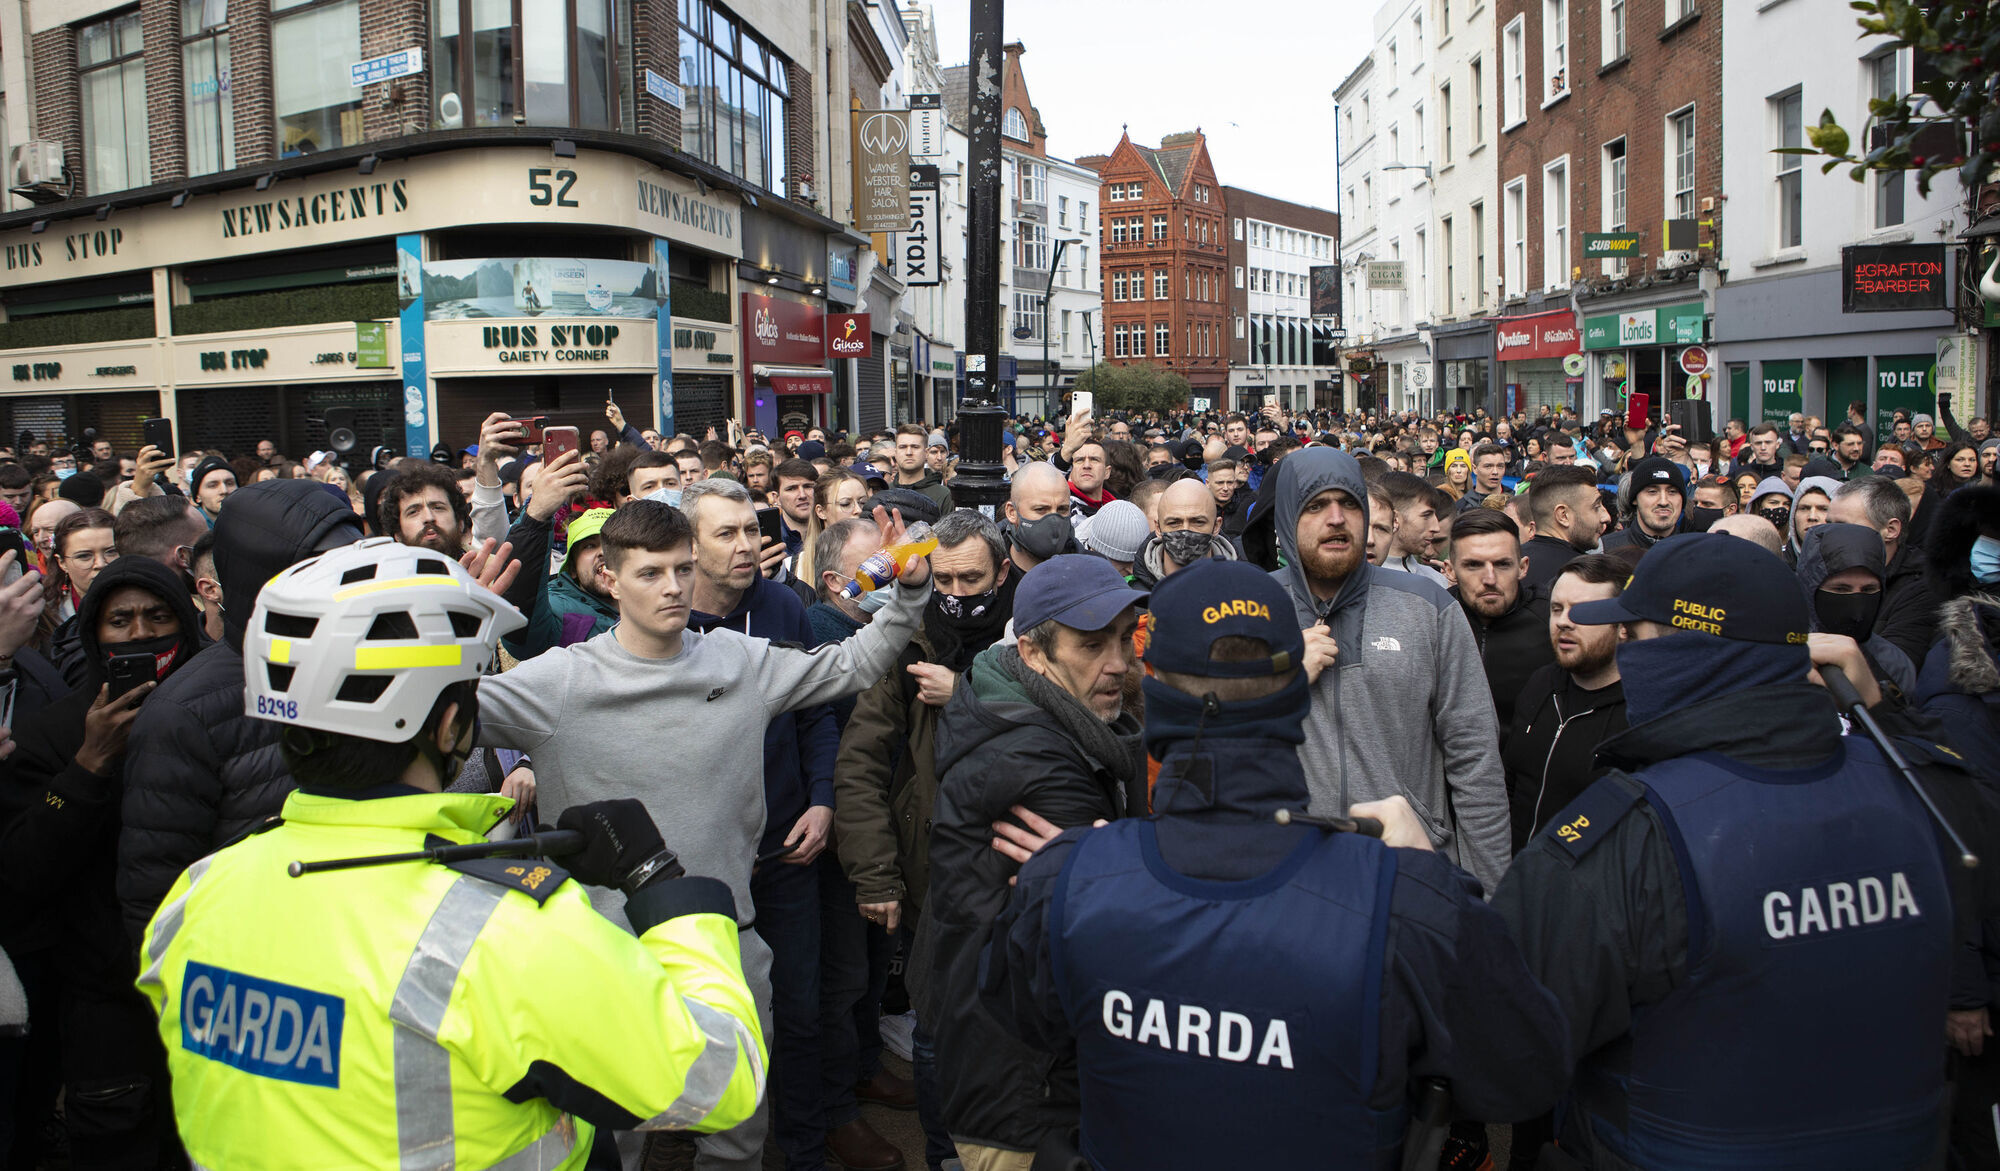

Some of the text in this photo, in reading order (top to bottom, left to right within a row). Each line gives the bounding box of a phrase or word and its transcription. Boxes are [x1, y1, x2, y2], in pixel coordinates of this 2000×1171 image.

[922, 111, 930, 154] FUJIFILM
[868, 163, 898, 174] WAYNE
[528, 168, 579, 208] 52
[864, 175, 907, 188] WEBSTER
[874, 187, 897, 198] HAIR
[222, 179, 409, 239] NEWSAGENTS
[637, 179, 733, 240] NEWSAGENTS
[871, 198, 899, 208] SALON
[907, 195, 931, 277] instax
[1588, 239, 1635, 251] SUBWAY
[6, 228, 124, 271] BUS STOP
[554, 271, 585, 279] UNSEEN
[1371, 271, 1402, 279] CIGAR
[1865, 262, 1942, 277] GRAFTON
[1864, 279, 1931, 293] BARBER
[755, 309, 778, 340] Gino's
[1623, 321, 1652, 341] Londis
[483, 324, 620, 349] BUS STOP
[832, 337, 864, 352] Gino's
[1504, 331, 1531, 347] vodafone
[231, 348, 269, 369] STOP
[499, 349, 609, 363] GAIETY CORNER
[33, 362, 62, 381] STOP
[1413, 366, 1427, 385] 3
[1880, 371, 1924, 388] TO LET
[1937, 366, 1956, 377] MHR
[1764, 379, 1796, 393] TO LET
[1202, 600, 1271, 624] GARDA
[1673, 598, 1727, 622] PUBLIC
[1671, 614, 1723, 637] ORDER
[1786, 631, 1809, 645] GAR
[258, 694, 298, 719] B298
[1571, 814, 1590, 829] P
[1557, 825, 1582, 842] 97
[504, 866, 526, 877] B
[521, 866, 552, 890] 298
[1762, 871, 1919, 940] GARDA
[185, 974, 334, 1075] GARDA
[1102, 989, 1295, 1070] GARDA
